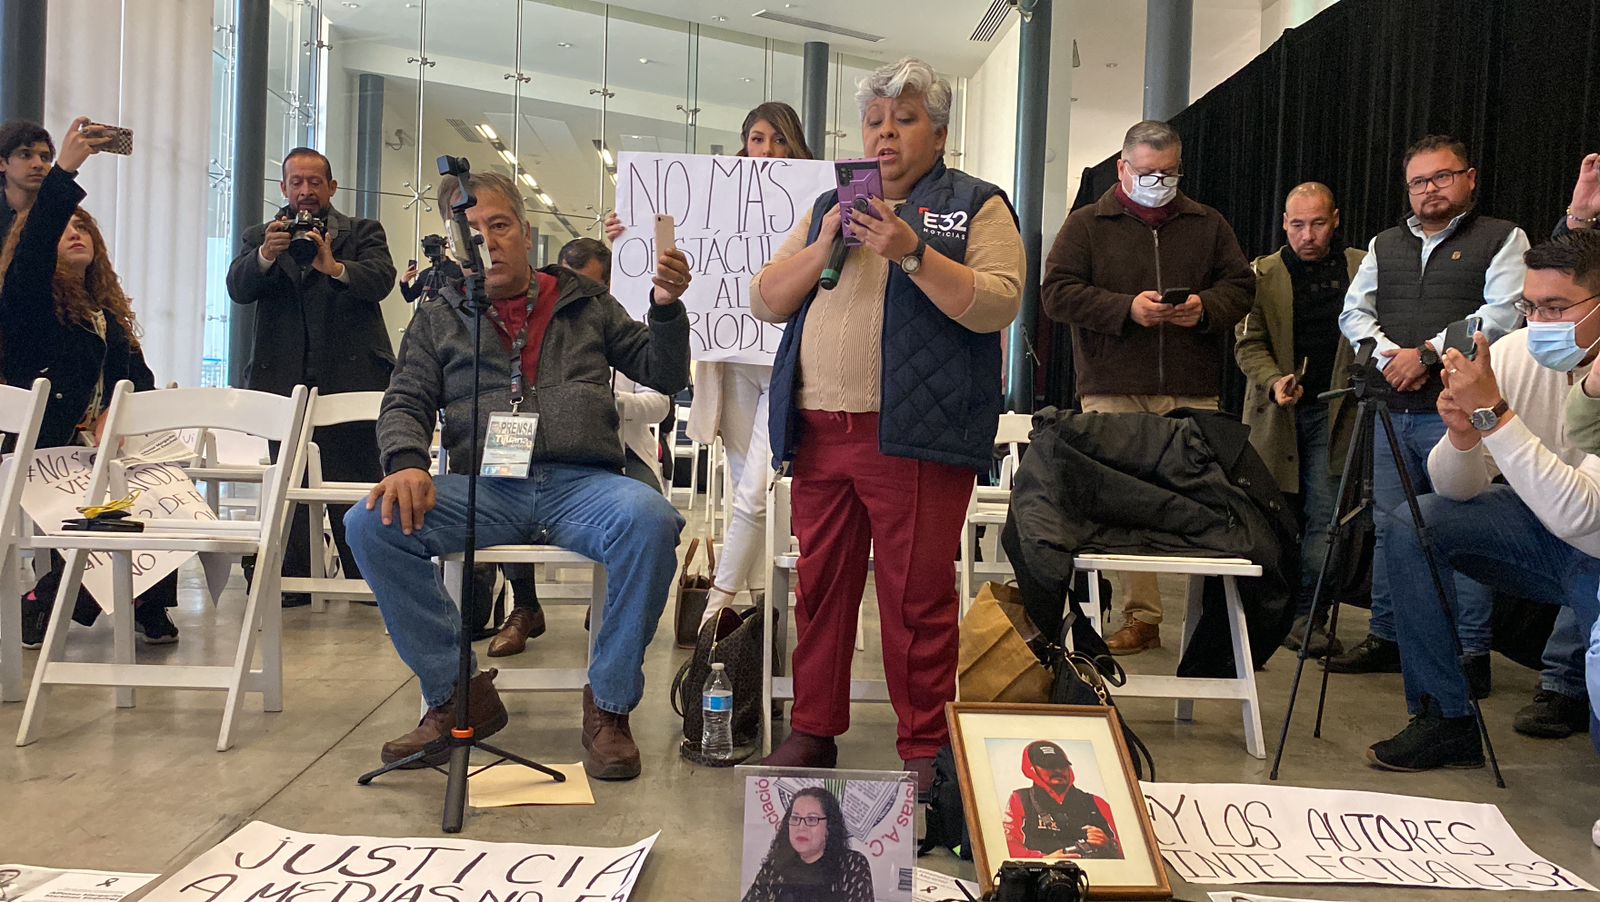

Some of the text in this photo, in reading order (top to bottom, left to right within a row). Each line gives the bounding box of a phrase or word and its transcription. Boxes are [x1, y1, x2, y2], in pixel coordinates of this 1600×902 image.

[629, 158, 795, 234] NO MÁS
[923, 210, 968, 232] E32
[923, 227, 966, 240] NOTICIAS
[500, 421, 533, 436] PRENSA
[1194, 799, 1281, 850] LOS
[1308, 808, 1495, 857] AUTORES
[235, 837, 646, 890] JUSTICIA
